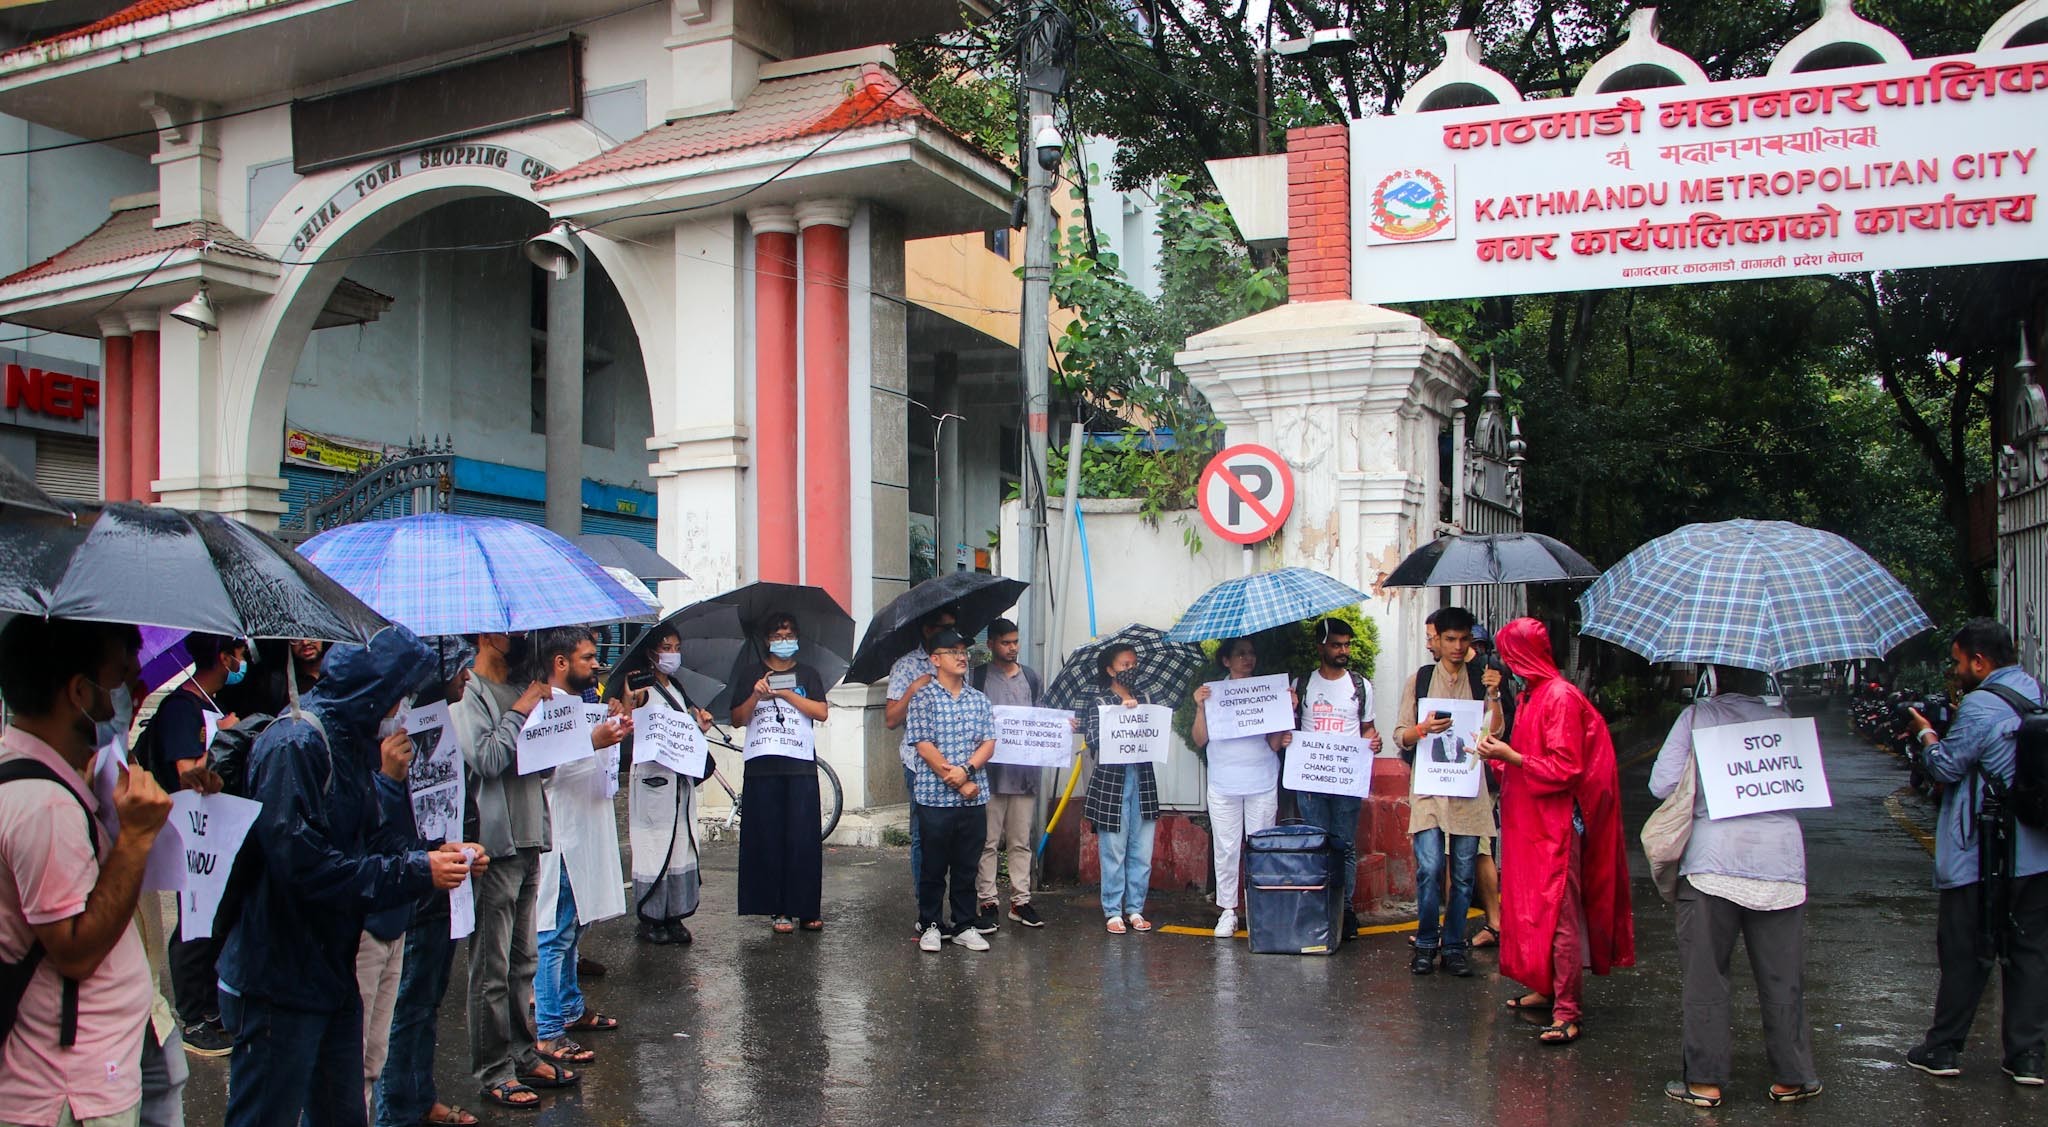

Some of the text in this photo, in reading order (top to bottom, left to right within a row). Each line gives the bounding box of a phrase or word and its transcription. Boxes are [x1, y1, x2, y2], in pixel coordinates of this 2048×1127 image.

[1474, 147, 2038, 222] KATHMANDU METROPOLITAN CITY
[294, 202, 341, 252] CHINA
[354, 159, 402, 197] TOWN
[420, 147, 508, 169] SHOPPING
[1475, 193, 2038, 262] नगर कार्यपालिकाको कार्यालय
[1793, 253, 1823, 268] प्रदेश
[1827, 251, 1864, 264] नेपाल
[1228, 465, 1273, 526] P
[1224, 685, 1270, 696] DOWN WITH
[1236, 707, 1264, 716] RACISM
[667, 718, 694, 730] OOTING
[1119, 714, 1149, 724] LIVABLE
[1238, 718, 1264, 727] ELITISM
[526, 726, 552, 740] EMPATHY
[1025, 730, 1057, 738] VENDORS
[1111, 728, 1159, 739] KATHMANDU
[1024, 740, 1061, 748] BUSINESSES
[1302, 741, 1324, 749] BALEN
[1744, 734, 1782, 750] STOP
[1120, 744, 1148, 754] FOR ALL
[1304, 763, 1336, 772] CHANGE
[1727, 756, 1802, 776] UNLAWFUL
[1301, 774, 1337, 783] PROMISED
[1736, 779, 1804, 799] POLICING
